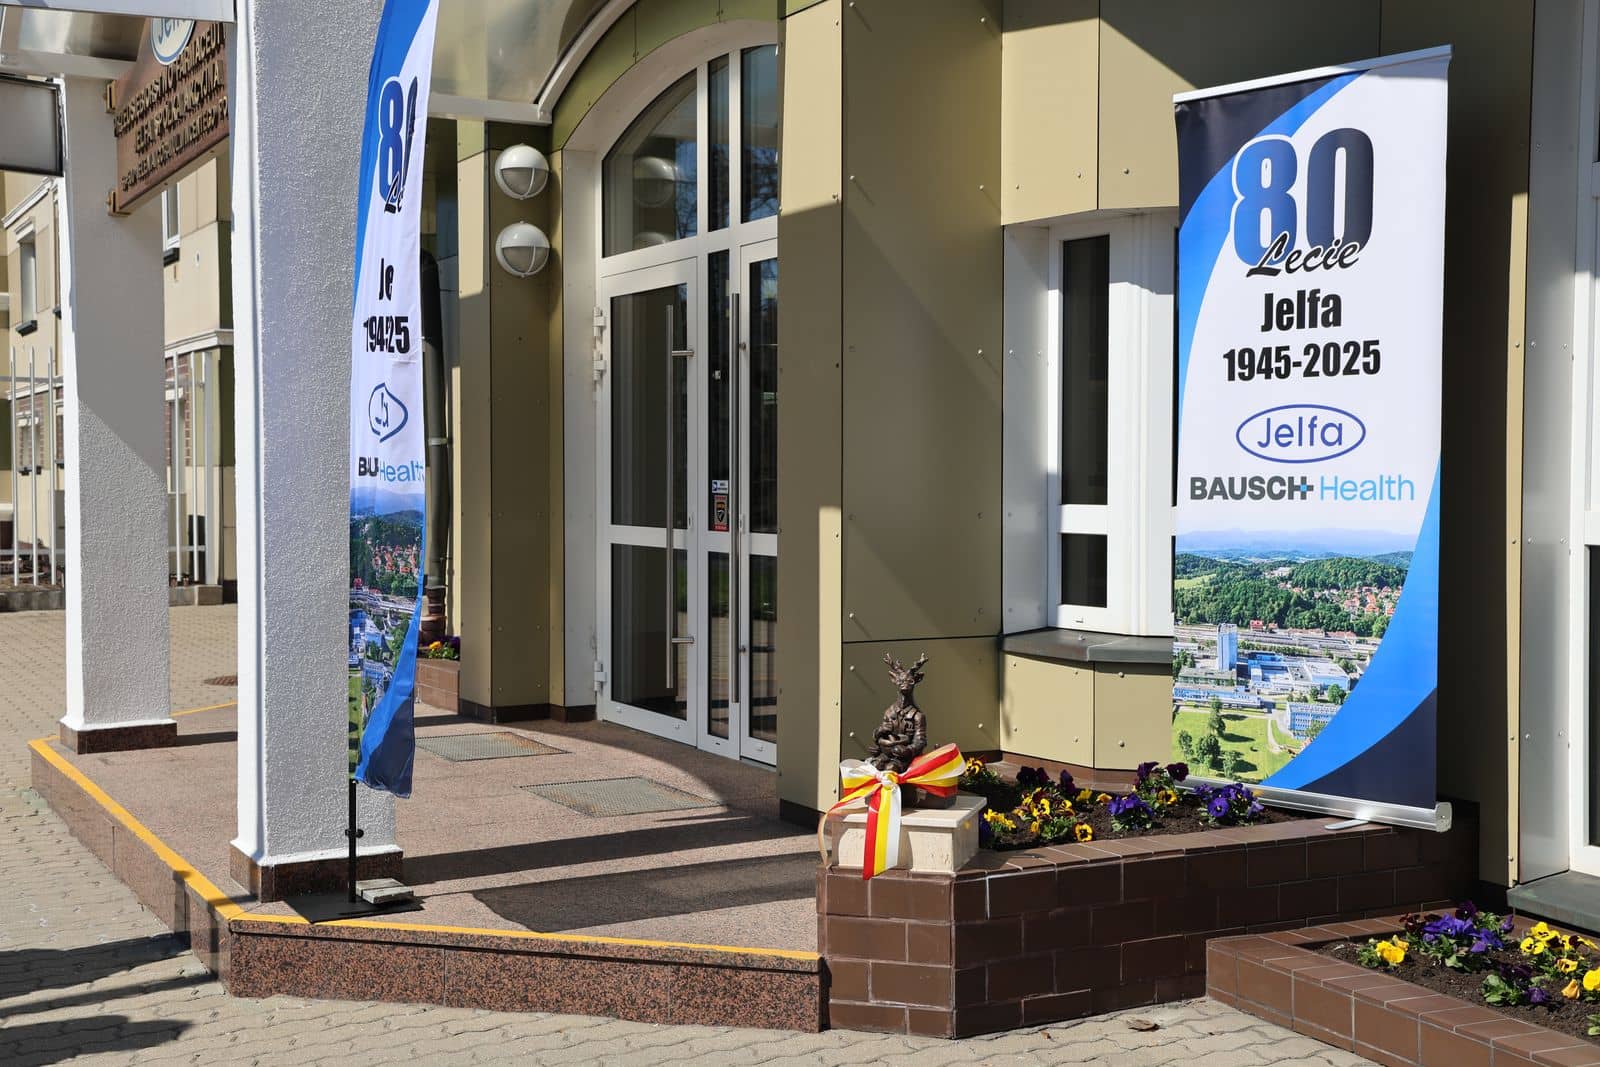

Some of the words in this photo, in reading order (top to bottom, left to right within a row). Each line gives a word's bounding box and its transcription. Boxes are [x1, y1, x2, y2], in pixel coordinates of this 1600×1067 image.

[1233, 127, 1375, 267] 80
[1245, 232, 1360, 278] Lecie
[1260, 288, 1343, 333] Jelfa
[1222, 339, 1382, 382] 1945-2025
[1256, 415, 1343, 449] Jelfa
[1319, 473, 1415, 502] Health
